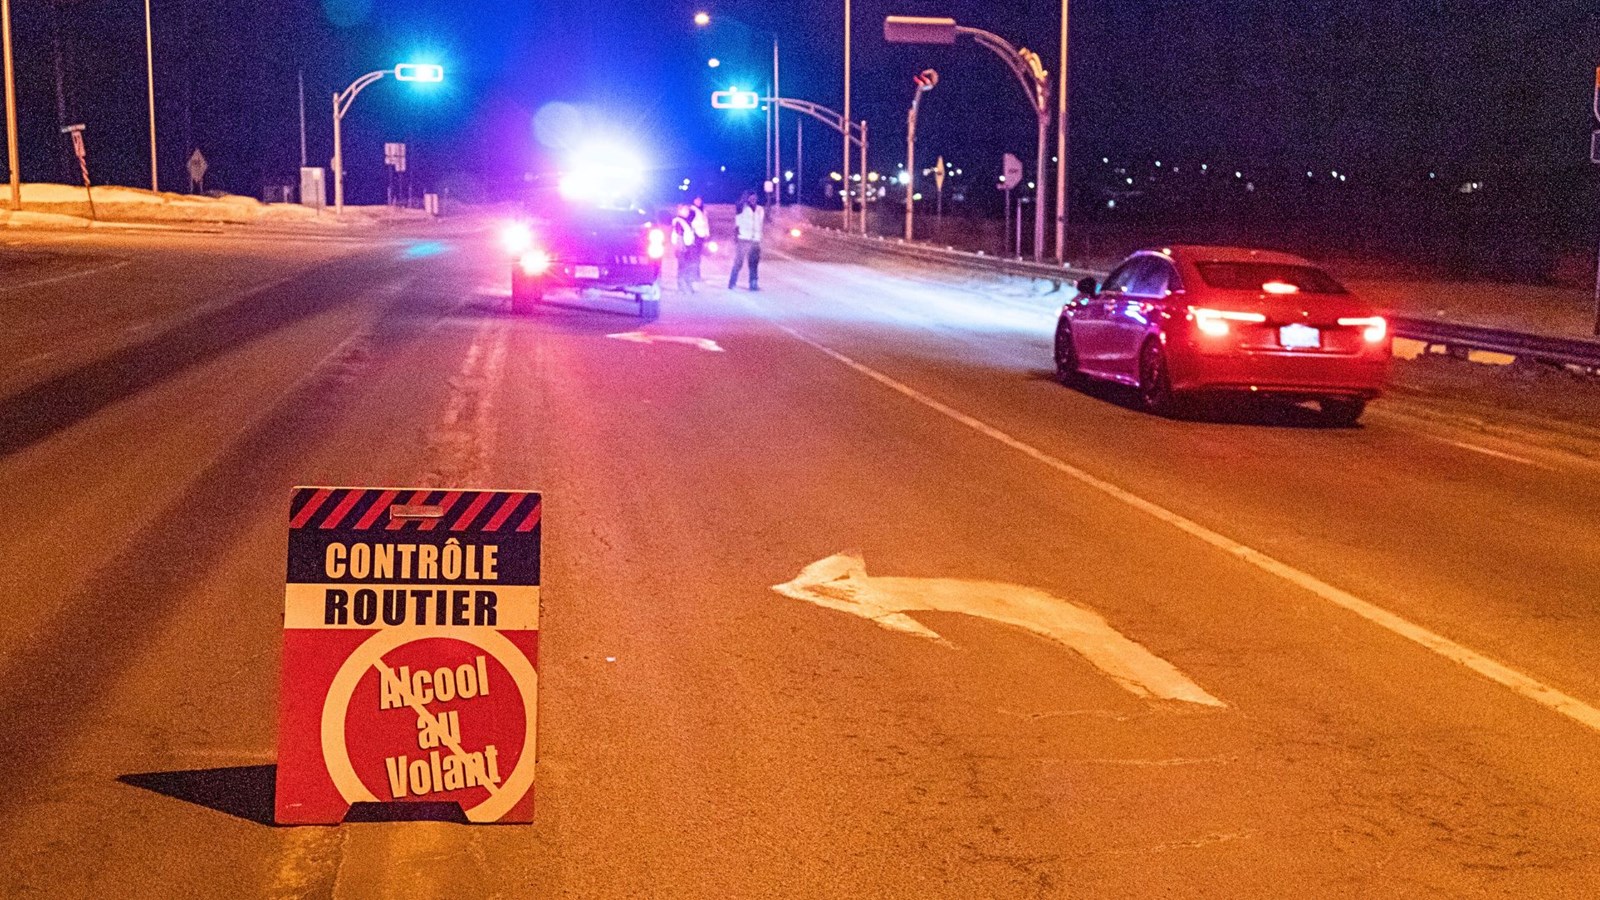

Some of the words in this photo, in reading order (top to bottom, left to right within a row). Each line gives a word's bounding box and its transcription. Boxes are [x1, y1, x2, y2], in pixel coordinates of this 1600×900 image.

[325, 537, 498, 580] CONTRÔLE
[324, 589, 498, 626] ROUTIER
[380, 655, 490, 710] Alcool
[417, 710, 461, 750] au
[385, 744, 501, 798] Volant
